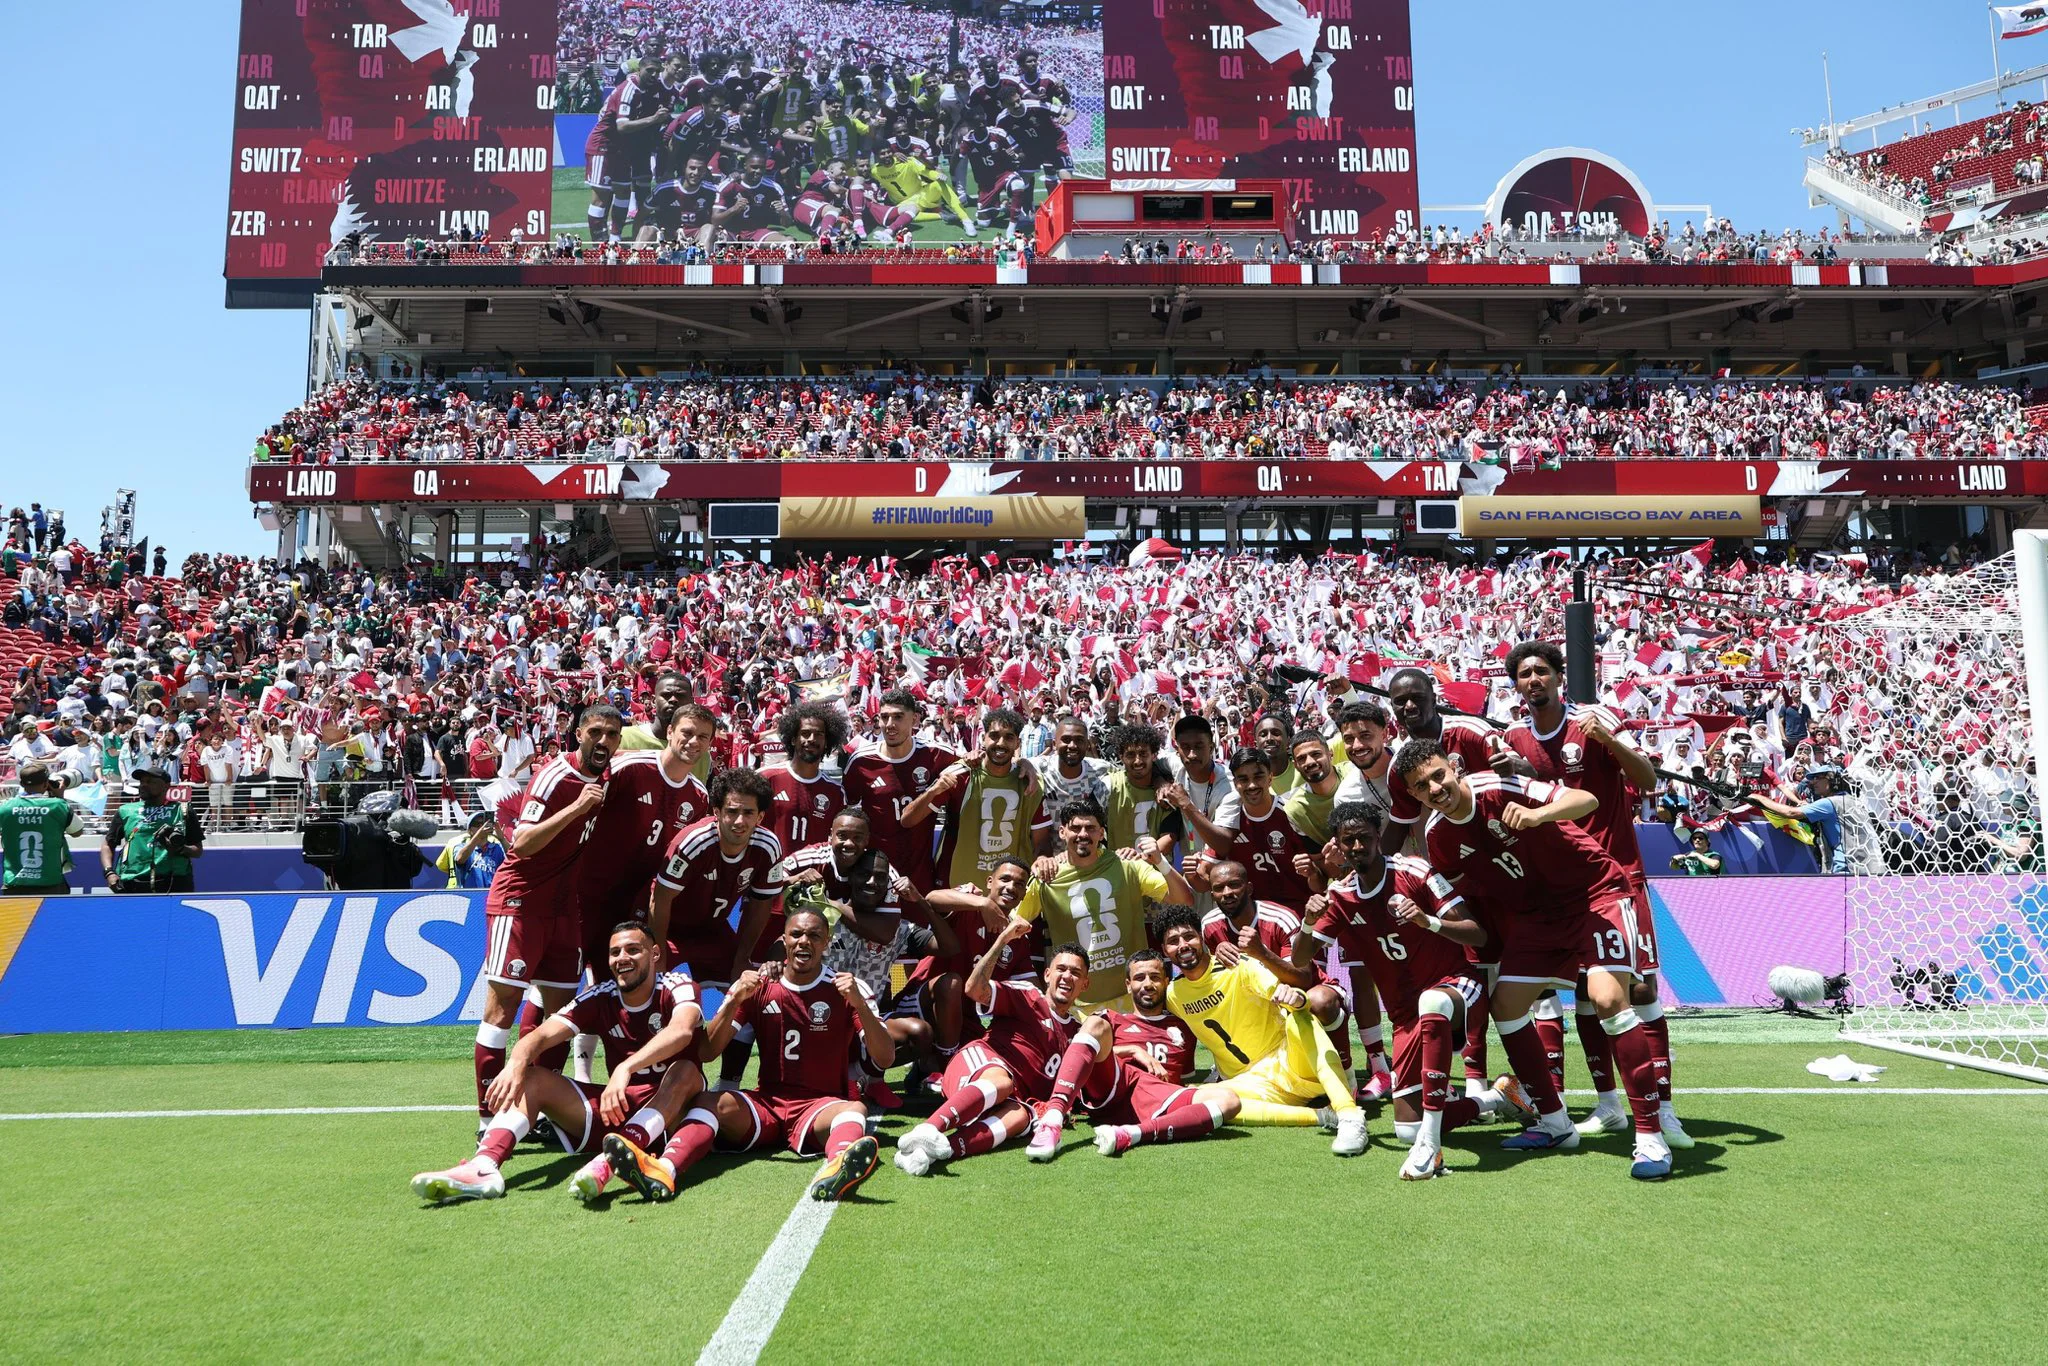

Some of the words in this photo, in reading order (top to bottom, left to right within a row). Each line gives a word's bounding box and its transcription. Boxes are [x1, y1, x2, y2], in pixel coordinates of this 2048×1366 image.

[352, 24, 387, 48] TAR
[472, 23, 498, 48] QA
[1209, 25, 1245, 49] TAR
[1327, 25, 1352, 50] QA
[244, 85, 280, 110] QAT
[425, 85, 451, 110] AR
[1110, 85, 1145, 110] QAT
[1286, 86, 1312, 110] AR
[240, 147, 303, 173] SWITZ
[473, 147, 547, 172] ERLAND
[1112, 147, 1171, 172] SWITZ
[1338, 147, 1410, 172] ERLAND
[230, 211, 266, 236] ZER
[1309, 209, 1359, 235] LAND
[286, 470, 336, 496] LAND
[413, 469, 438, 496] QA
[1133, 466, 1183, 492] LAND
[1257, 465, 1283, 492] QA
[1957, 465, 2007, 491] LAND
[872, 506, 993, 527] #FIFAWorldCup
[1479, 510, 1521, 521] SAN
[1525, 510, 1641, 521] FRANCISCO
[1646, 510, 1685, 521] BAY
[1688, 510, 1743, 521] AREA
[1488, 669, 1508, 677] QATA
[1694, 674, 1720, 684] QATAR
[12, 806, 50, 815] PHOTO
[18, 816, 43, 824] 0141
[646, 819, 663, 846] 3
[792, 816, 808, 841] 11
[1252, 852, 1281, 873] 24
[1492, 851, 1524, 880] 13
[713, 898, 728, 918] 7
[1091, 933, 1111, 944] FIFA
[1376, 932, 1409, 961] 15
[1593, 931, 1626, 960] 13
[180, 893, 487, 1025] VIS
[1089, 951, 1109, 961] ORLD
[1109, 946, 1124, 956] CUP
[784, 1029, 800, 1061] 2
[1146, 1041, 1168, 1064] 16
[1203, 1019, 1251, 1065] 1
[1044, 1052, 1062, 1078] 8
